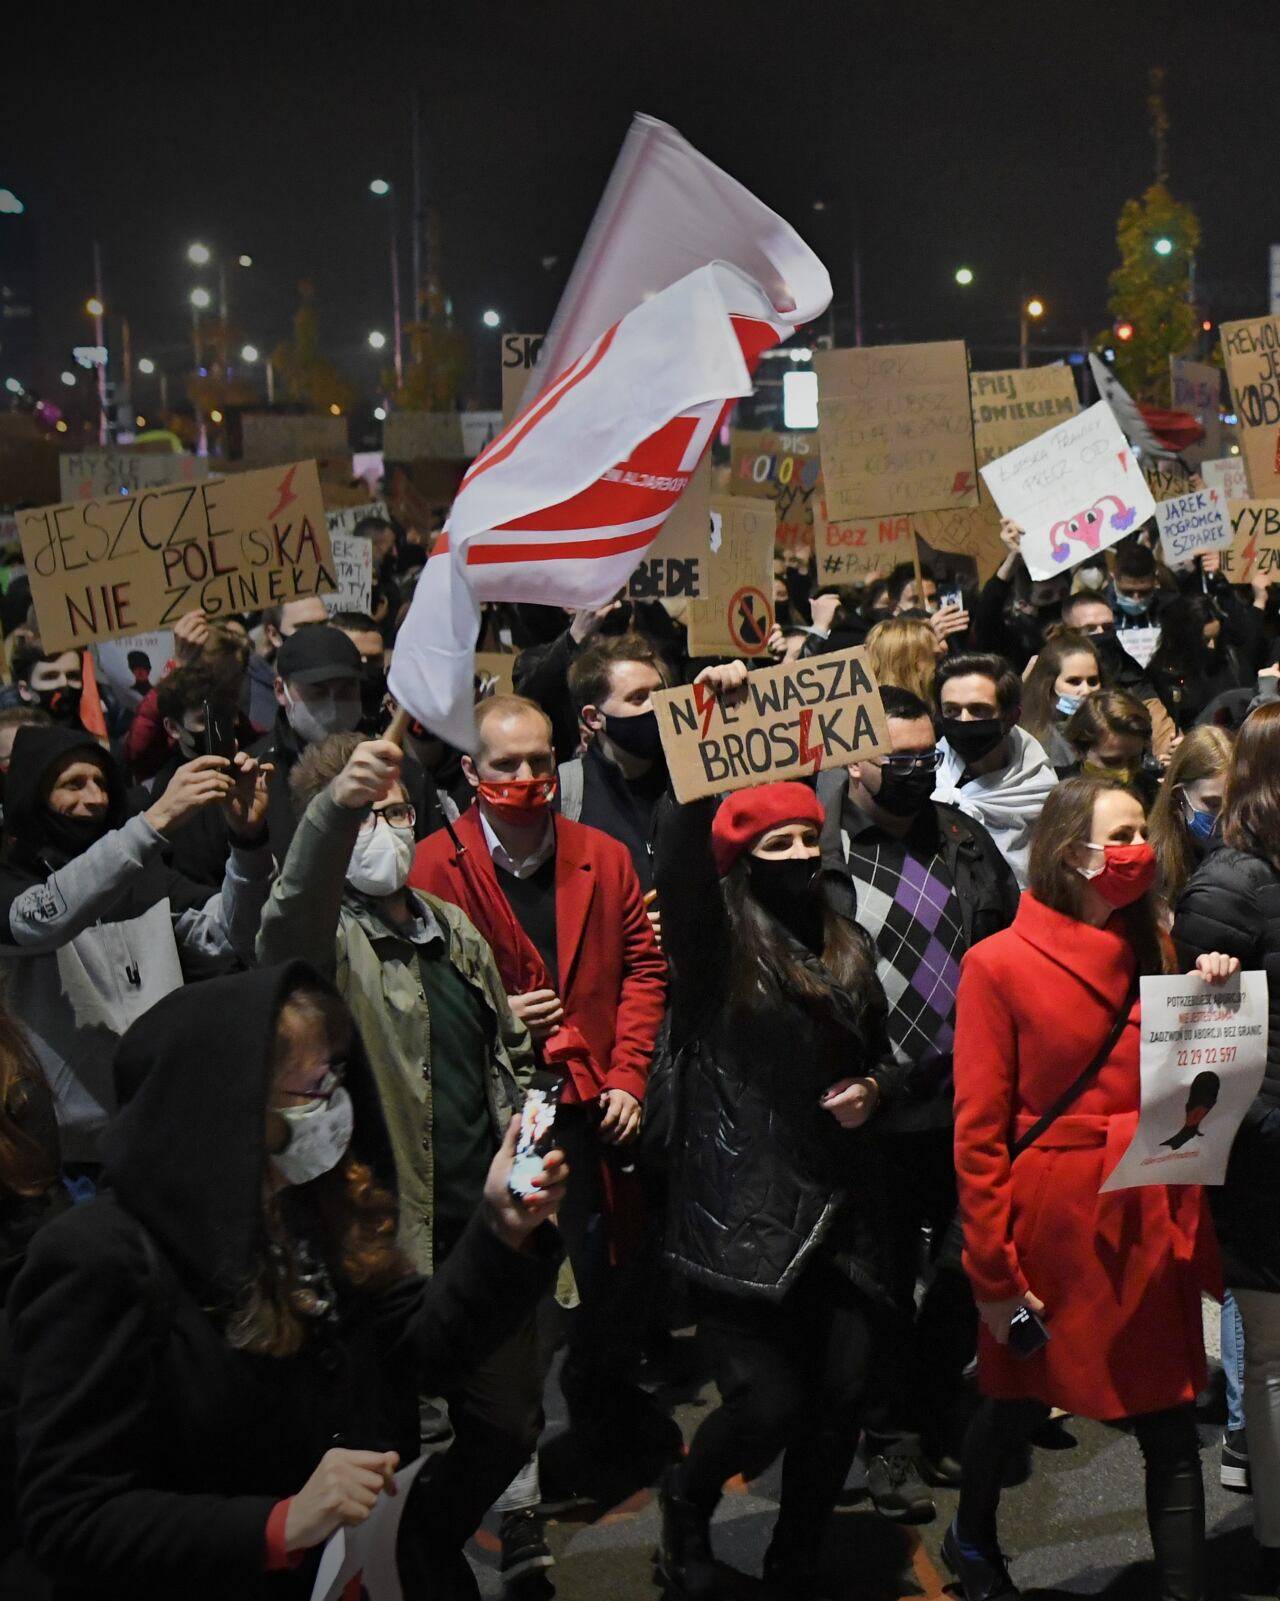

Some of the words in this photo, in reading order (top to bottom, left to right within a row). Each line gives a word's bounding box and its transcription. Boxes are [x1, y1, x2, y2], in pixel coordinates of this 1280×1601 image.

[24, 479, 234, 577] JESZCZE
[1162, 511, 1222, 537] POGROMCA
[1165, 493, 1207, 521] JAREK
[1172, 524, 1226, 557] SZPAREK
[65, 581, 137, 637] NIE
[751, 658, 873, 716] WASZA
[698, 704, 878, 783] BROSZKA
[1177, 1050, 1188, 1067] 22
[1190, 1049, 1202, 1065] 29
[1205, 1048, 1217, 1064] 22
[1220, 1046, 1237, 1063] 597
